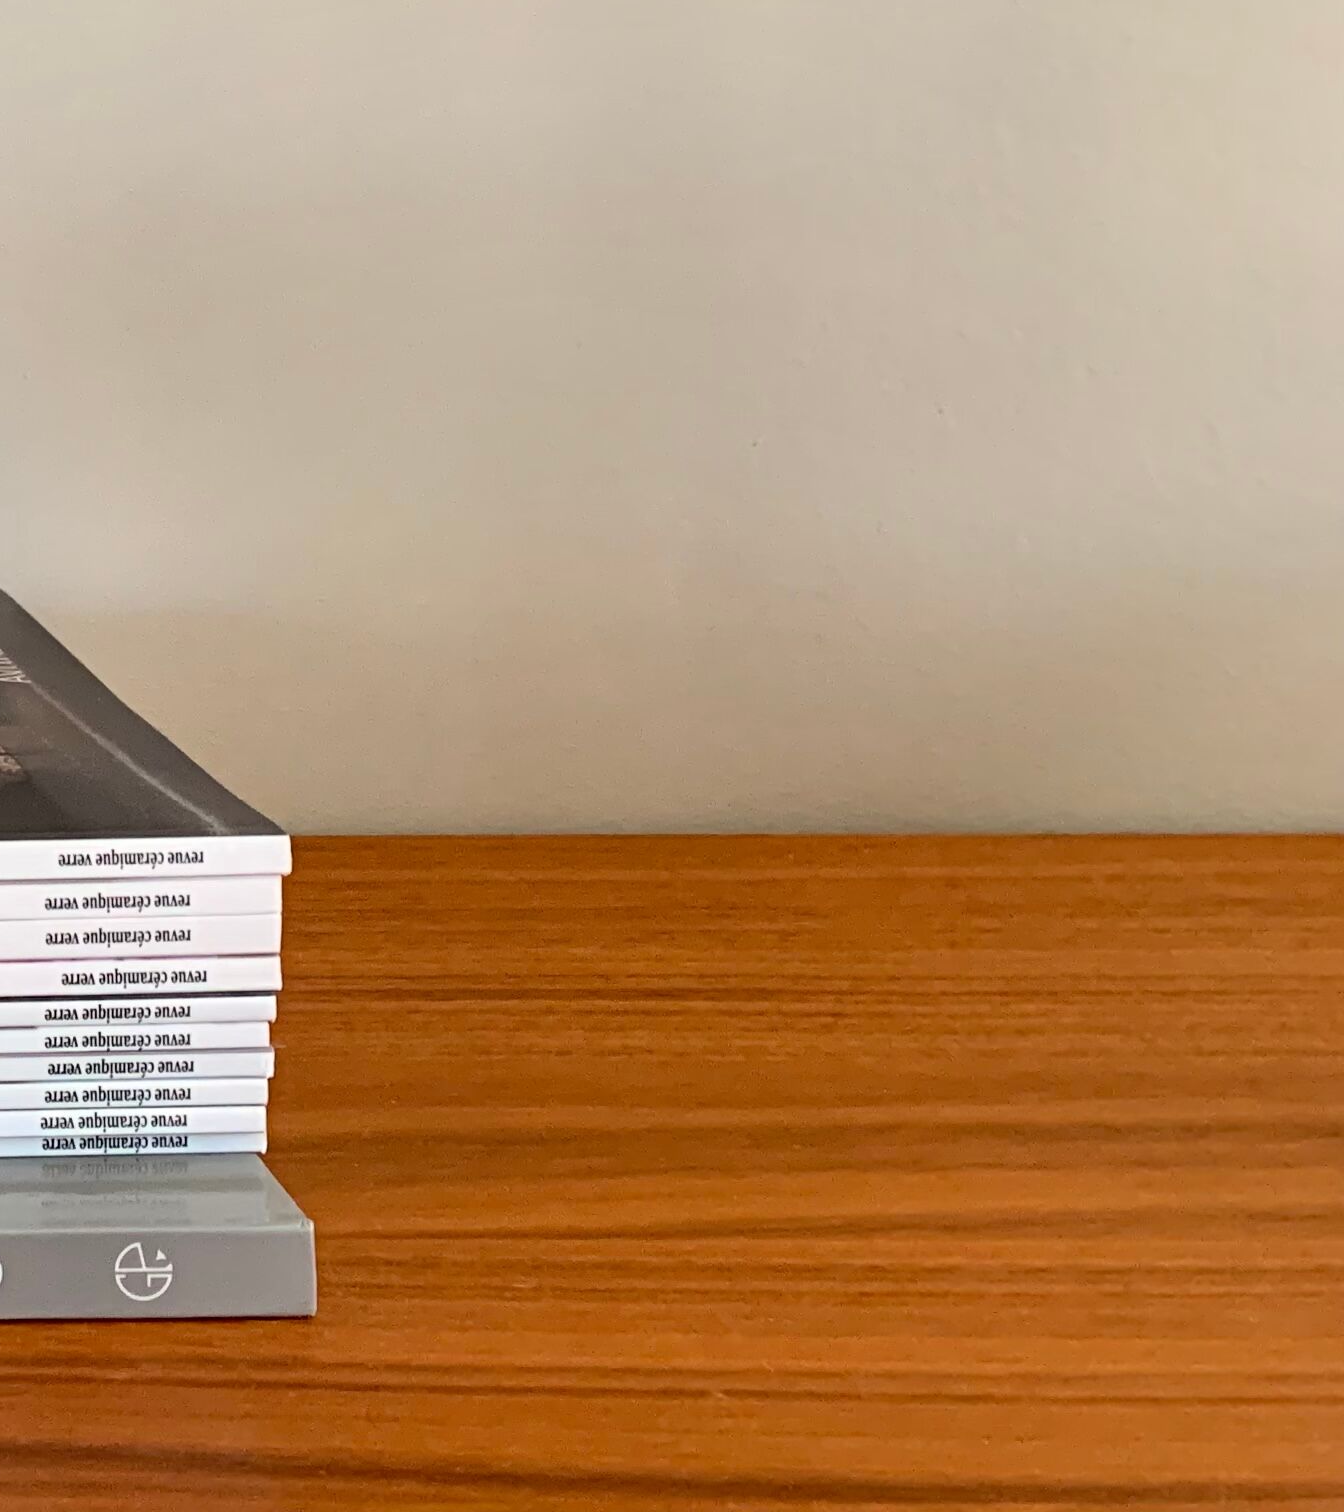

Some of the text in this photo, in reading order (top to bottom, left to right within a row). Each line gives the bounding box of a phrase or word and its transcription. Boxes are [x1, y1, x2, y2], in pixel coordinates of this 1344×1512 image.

[58, 849, 204, 869] revue céramique verre
[44, 893, 191, 913] revue céramique verre
[44, 928, 192, 948] revue céramique verre
[60, 969, 208, 989] revue céramique verre
[44, 1004, 191, 1024] revue céramique verre
[44, 1032, 191, 1052] revue céramique verre
[47, 1059, 194, 1079] revue céramique verre
[44, 1086, 192, 1106] revue céramique verre
[40, 1113, 188, 1133] revue céramique verre
[42, 1134, 188, 1154] revue céramique verre
